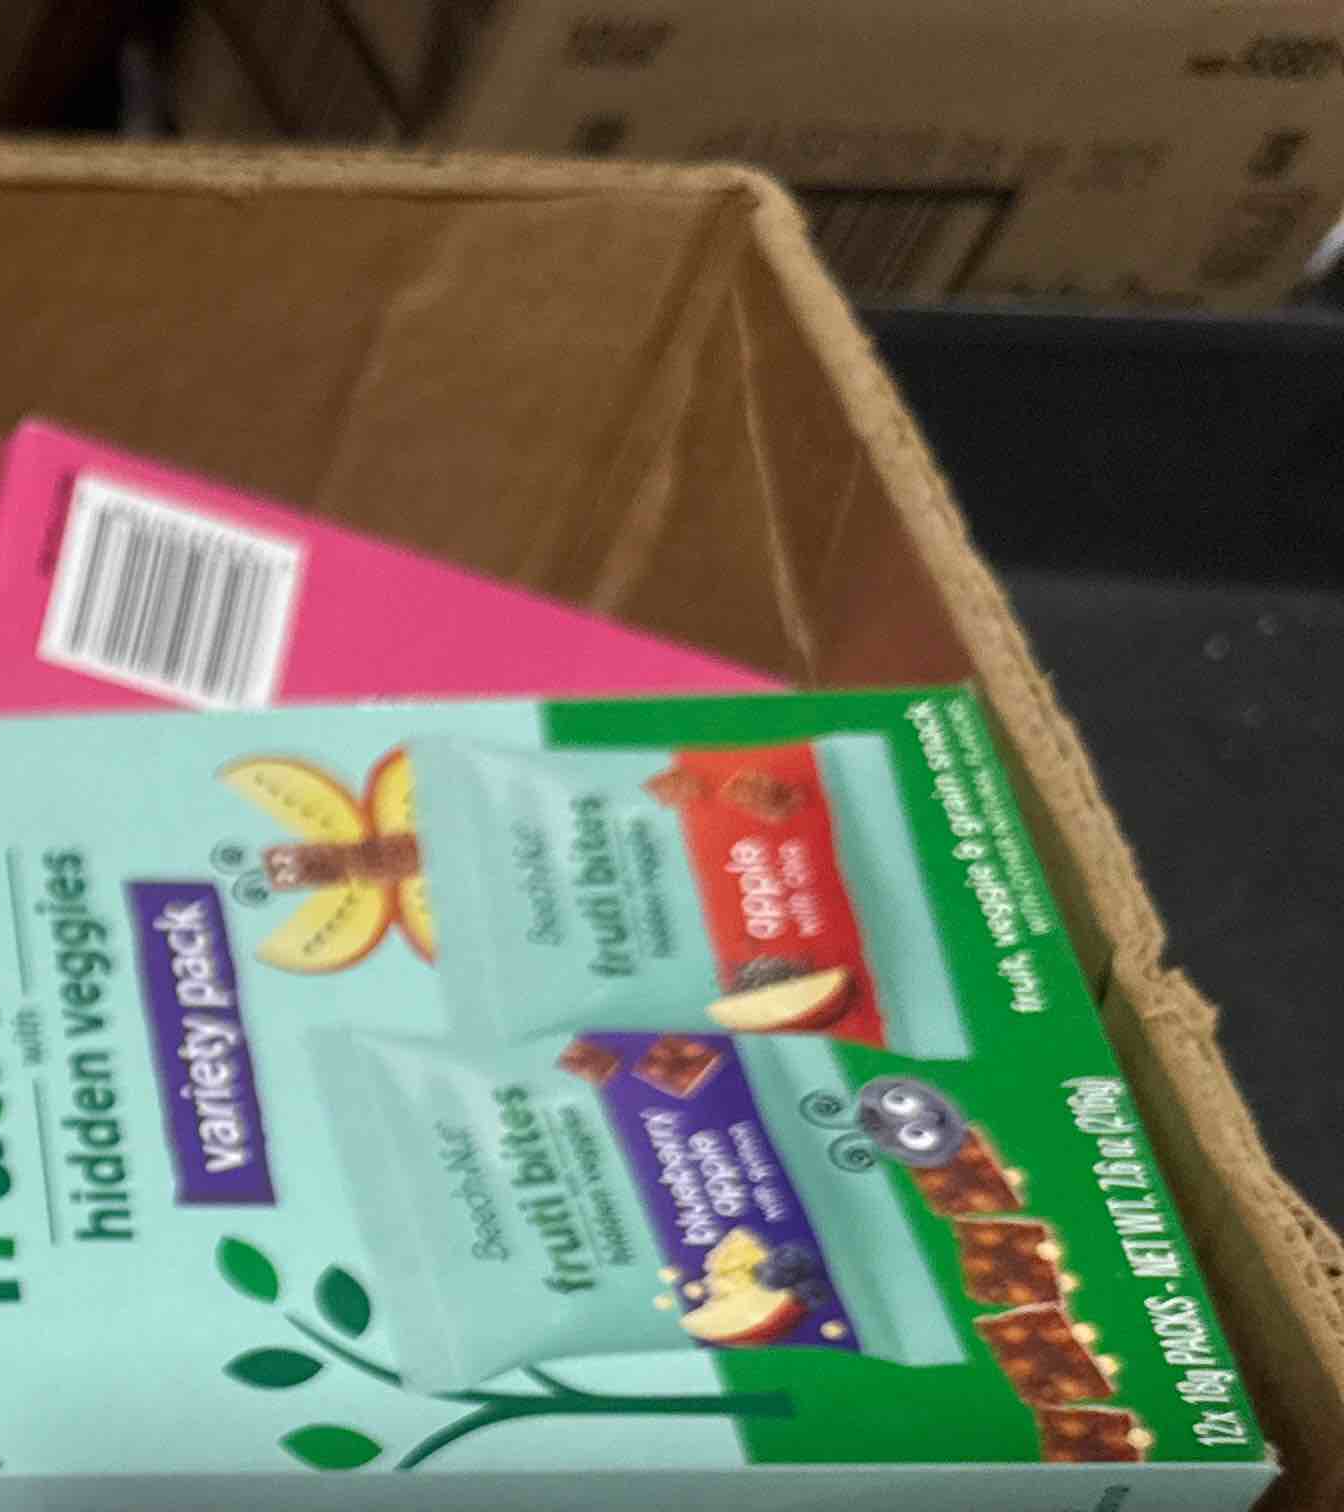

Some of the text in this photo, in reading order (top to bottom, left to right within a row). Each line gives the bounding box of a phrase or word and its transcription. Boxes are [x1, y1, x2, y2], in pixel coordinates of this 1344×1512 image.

[724, 838, 782, 939] apple
[12, 1008, 44, 1068] with
[33, 850, 134, 1243] hidden veggies
[152, 901, 249, 1173] variety pack
[491, 1086, 596, 1295] fruti bites
[687, 1129, 745, 1217] apple
[1122, 1239, 1183, 1277] NET
[1143, 1294, 1213, 1366] PACKS
